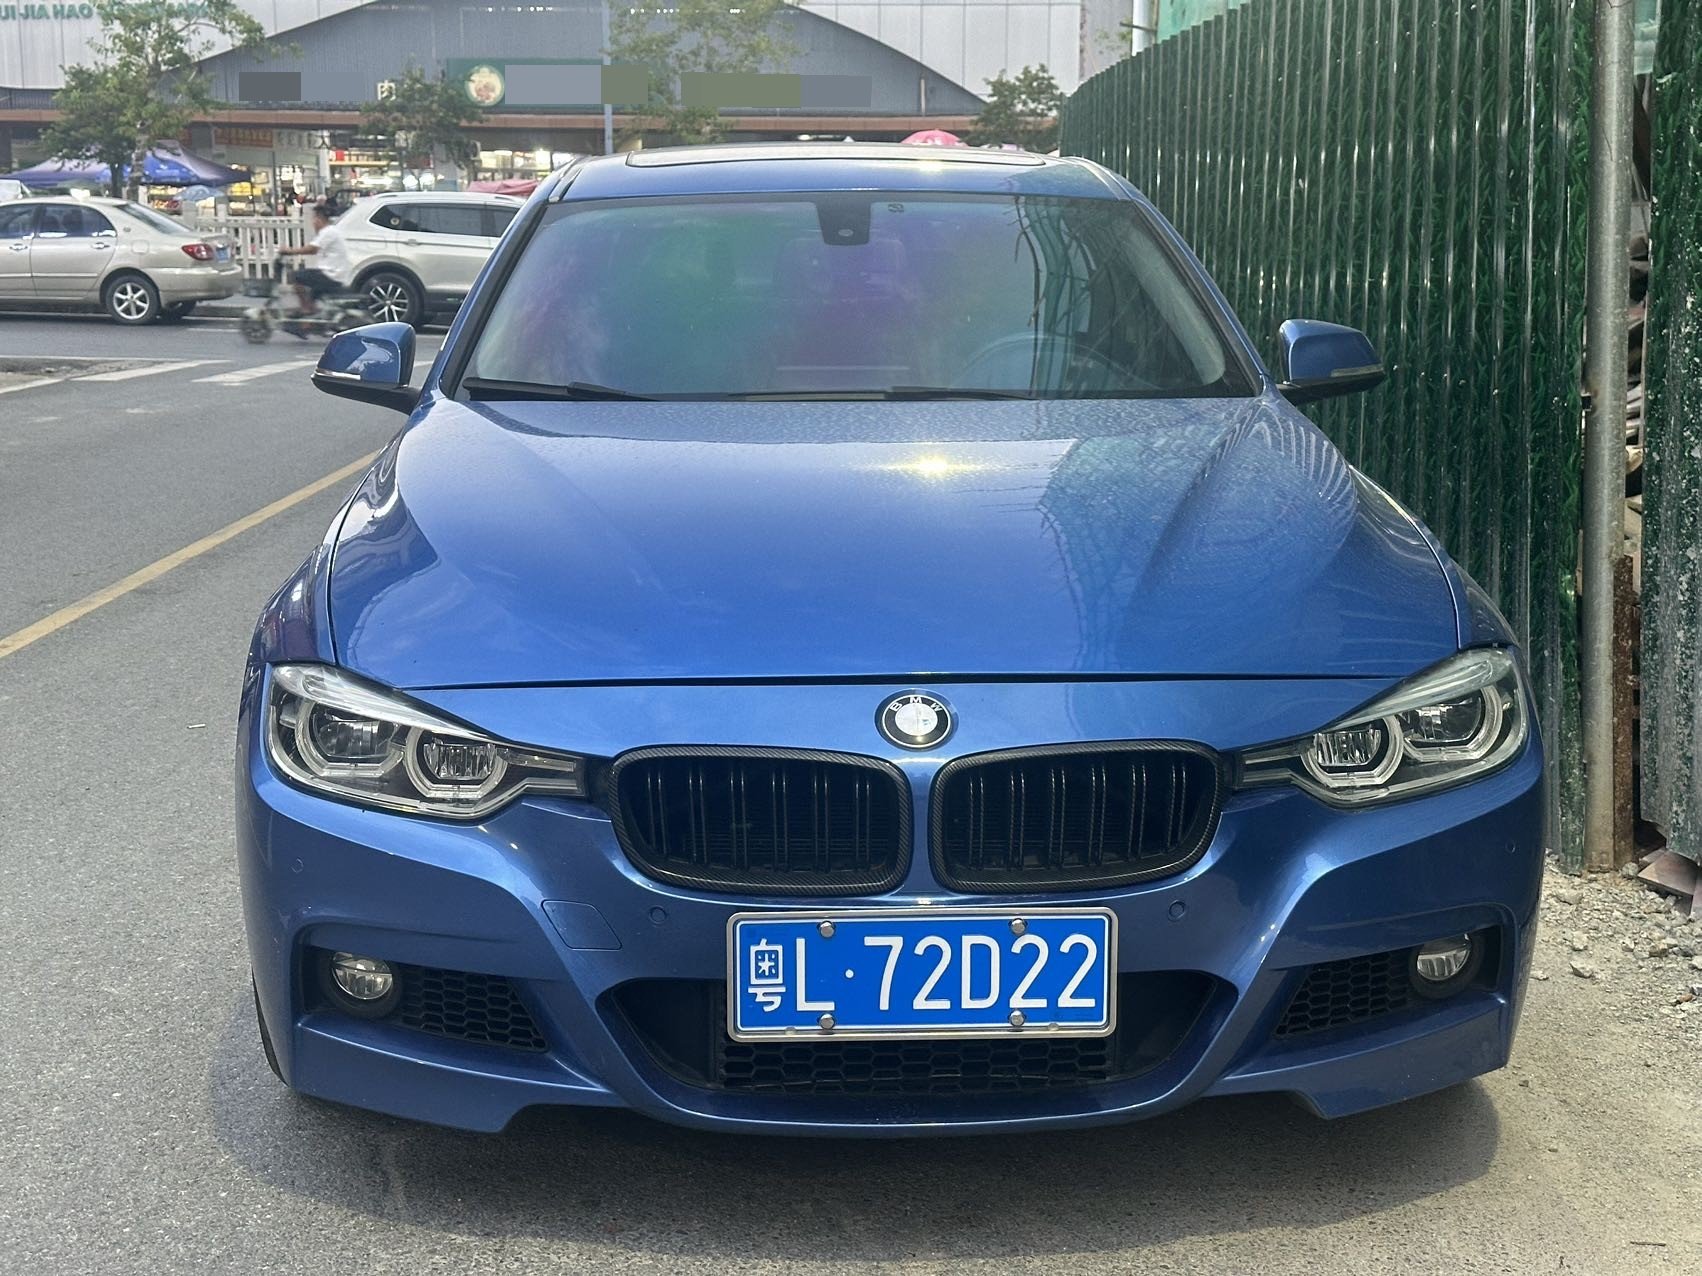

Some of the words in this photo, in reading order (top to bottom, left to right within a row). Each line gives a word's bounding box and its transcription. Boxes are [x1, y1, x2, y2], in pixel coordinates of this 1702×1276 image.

[19, 4, 50, 20] JIA
[52, 3, 93, 19] HAO
[377, 80, 396, 101] 肉
[889, 696, 943, 712] BMW
